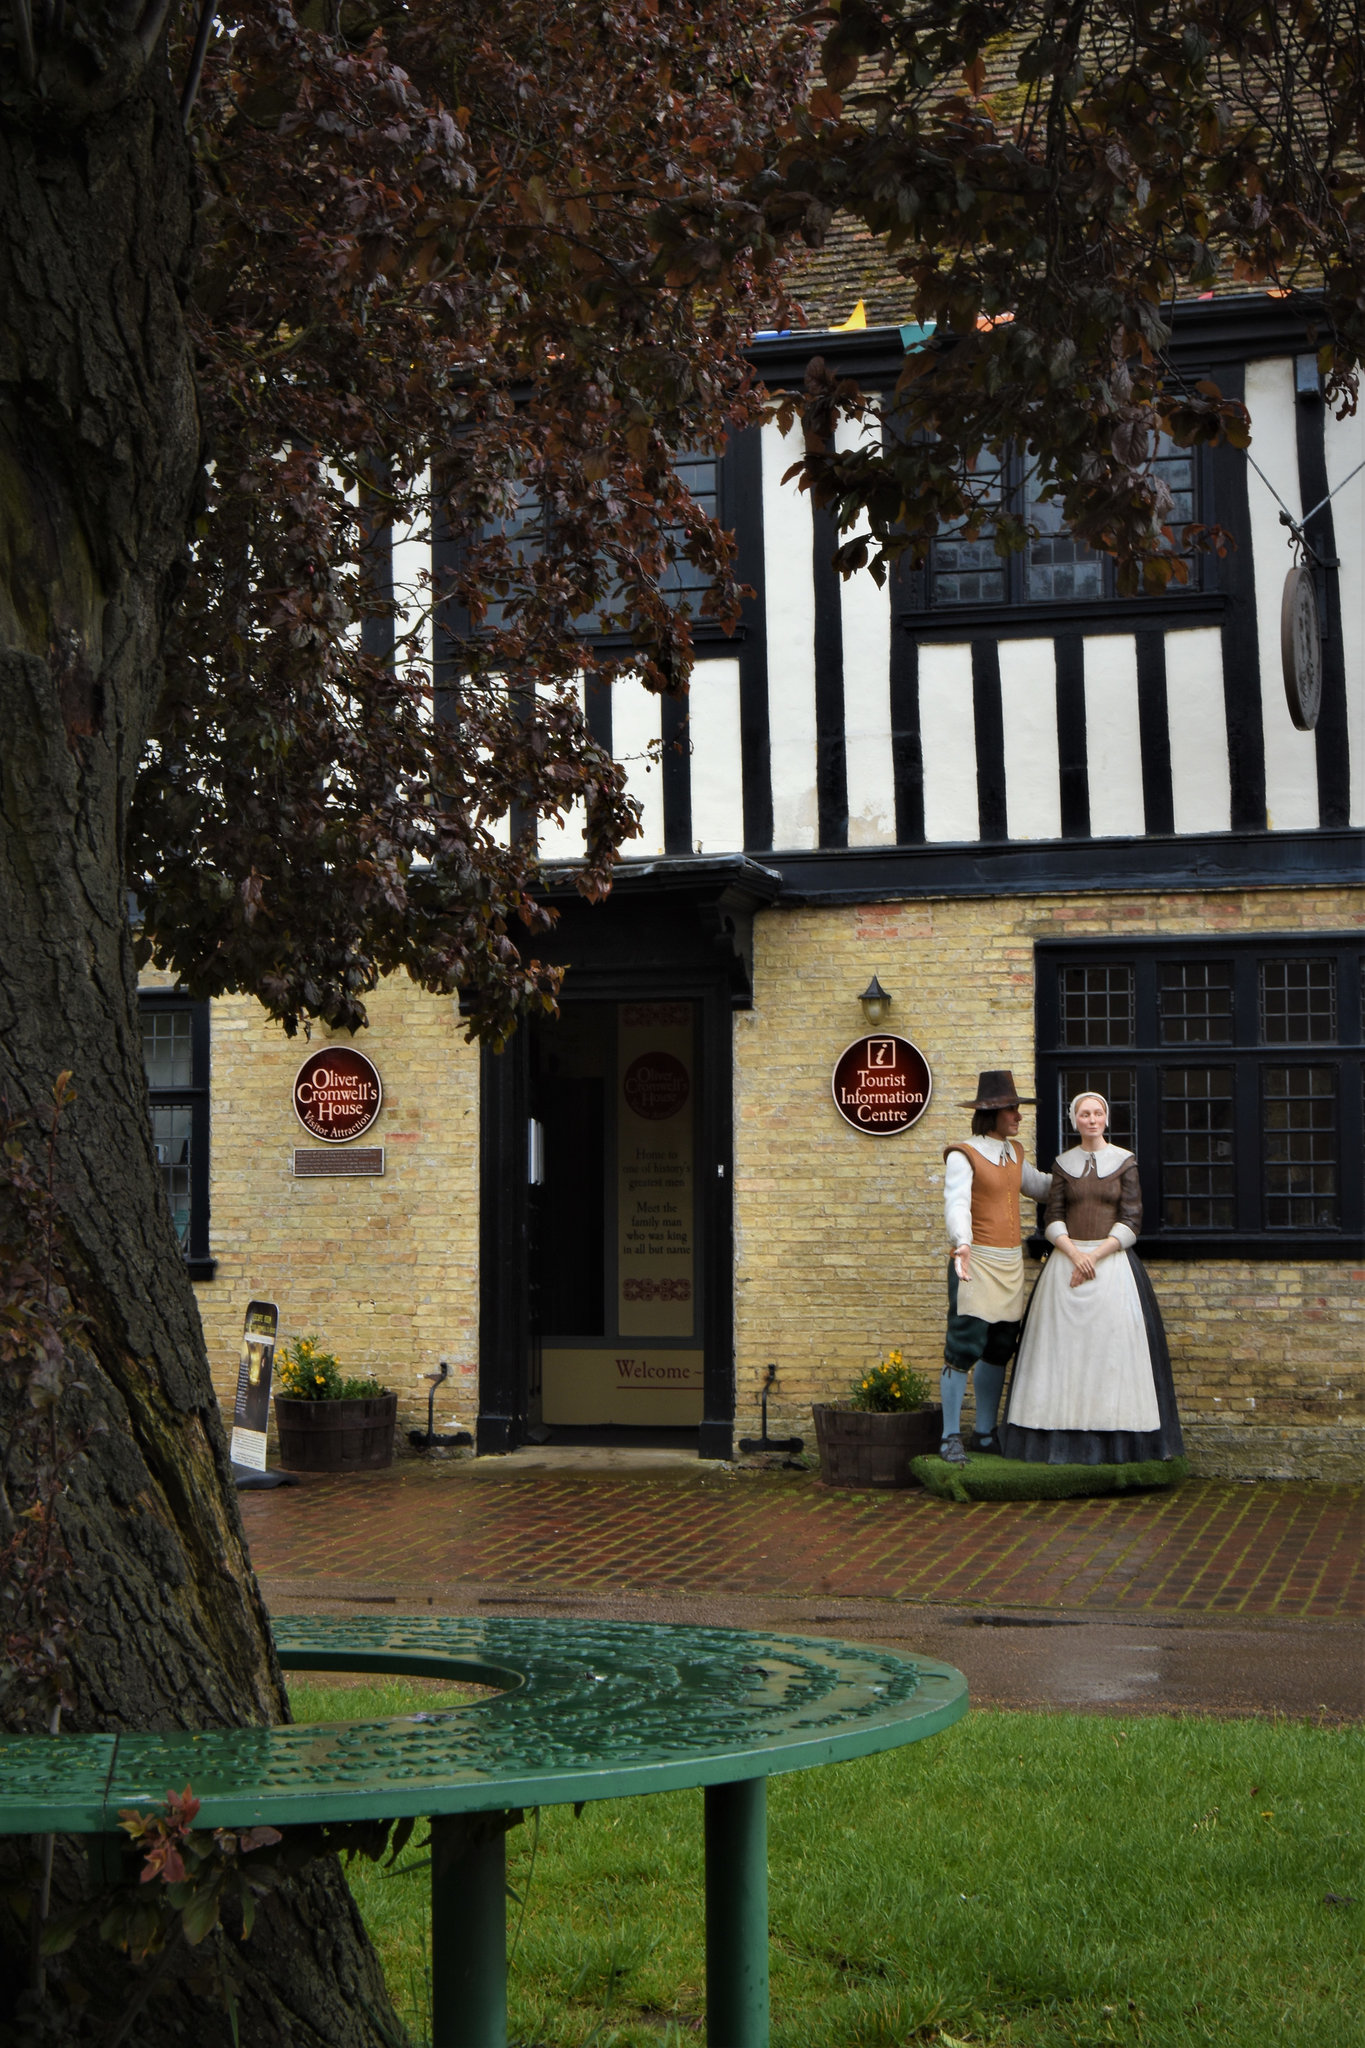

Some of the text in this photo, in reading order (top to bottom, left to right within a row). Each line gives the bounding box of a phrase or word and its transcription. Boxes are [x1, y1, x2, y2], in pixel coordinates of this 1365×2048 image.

[312, 1068, 358, 1089] Oliver
[638, 1066, 673, 1082] Oliver
[857, 1070, 906, 1088] Tourist
[297, 1082, 378, 1104] Cromwell's
[626, 1077, 688, 1094] Cromwell's
[641, 1092, 678, 1106] House
[841, 1087, 924, 1104] Information
[318, 1102, 363, 1120] House
[857, 1104, 908, 1122] Centre
[304, 1110, 371, 1138] Visitor Attraction
[636, 1147, 678, 1160] Home to
[642, 1162, 651, 1173] of
[654, 1161, 690, 1176] history's
[637, 1201, 678, 1213] Meet the
[632, 1216, 660, 1230] family
[626, 1229, 645, 1240] who
[667, 1230, 688, 1245] king
[624, 1244, 632, 1254] in
[635, 1244, 645, 1254] all
[649, 1244, 664, 1254] but
[614, 1359, 690, 1378] Welcome
